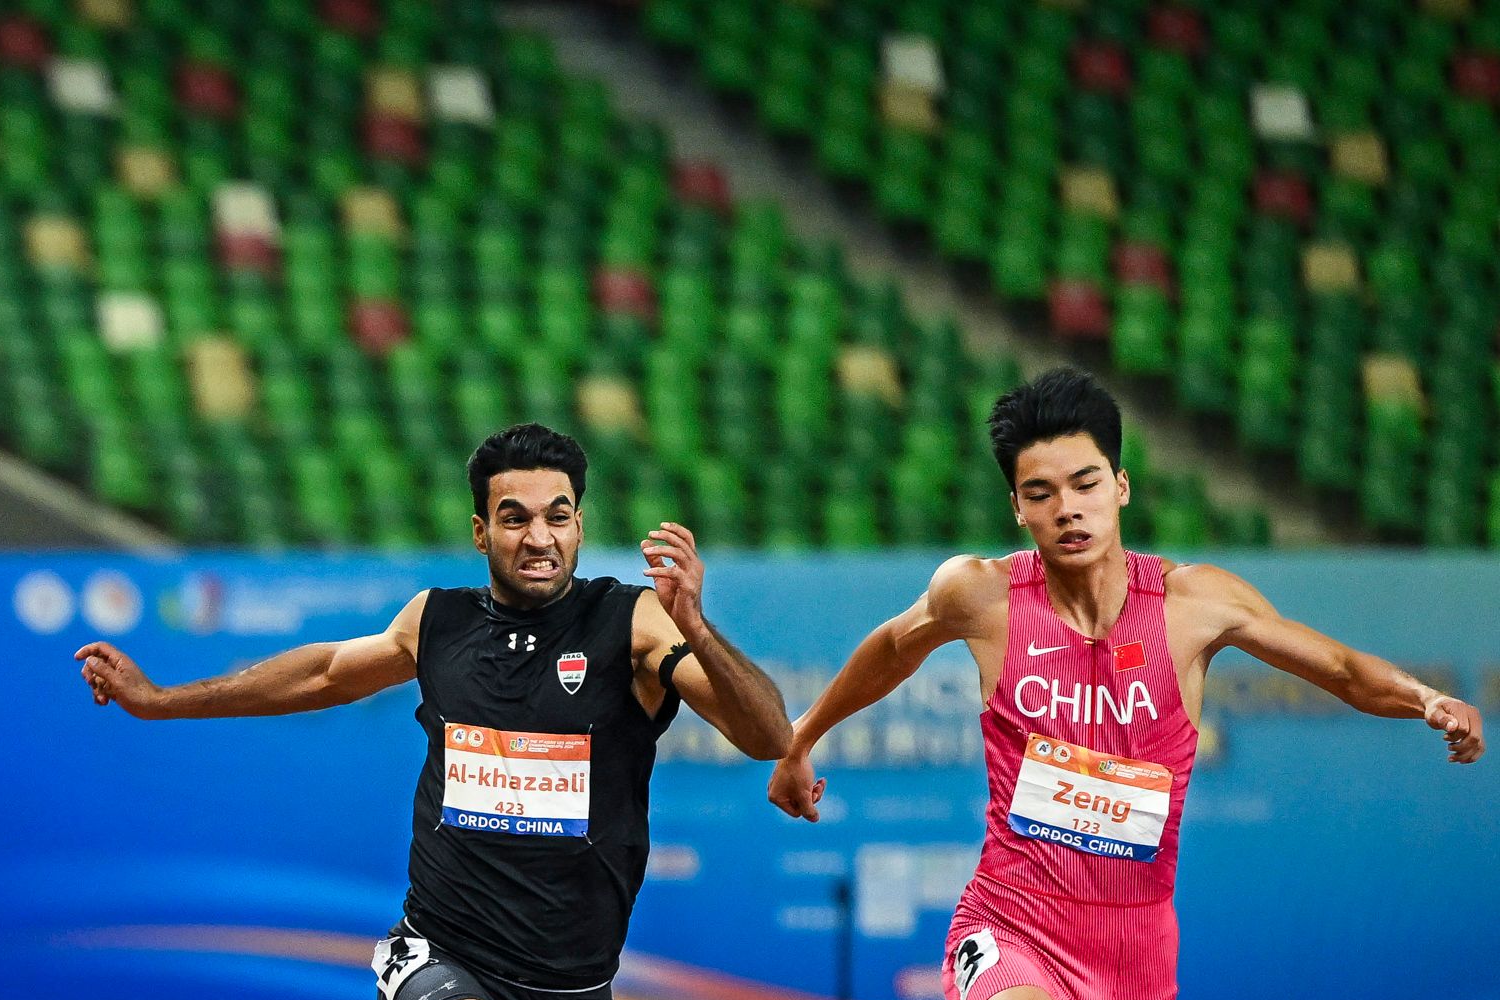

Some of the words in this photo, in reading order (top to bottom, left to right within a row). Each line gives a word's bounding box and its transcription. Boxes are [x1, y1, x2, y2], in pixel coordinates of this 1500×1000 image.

[1014, 674, 1158, 725] CHINA
[447, 762, 585, 793] Al-khazaali
[494, 801, 525, 816] 423
[1052, 780, 1132, 824] Zeng
[458, 813, 510, 830] ORDOS
[516, 820, 564, 834] CHINA
[1072, 818, 1101, 835] 123
[1028, 824, 1082, 847] ORDOS
[1088, 839, 1134, 858] CHINA
